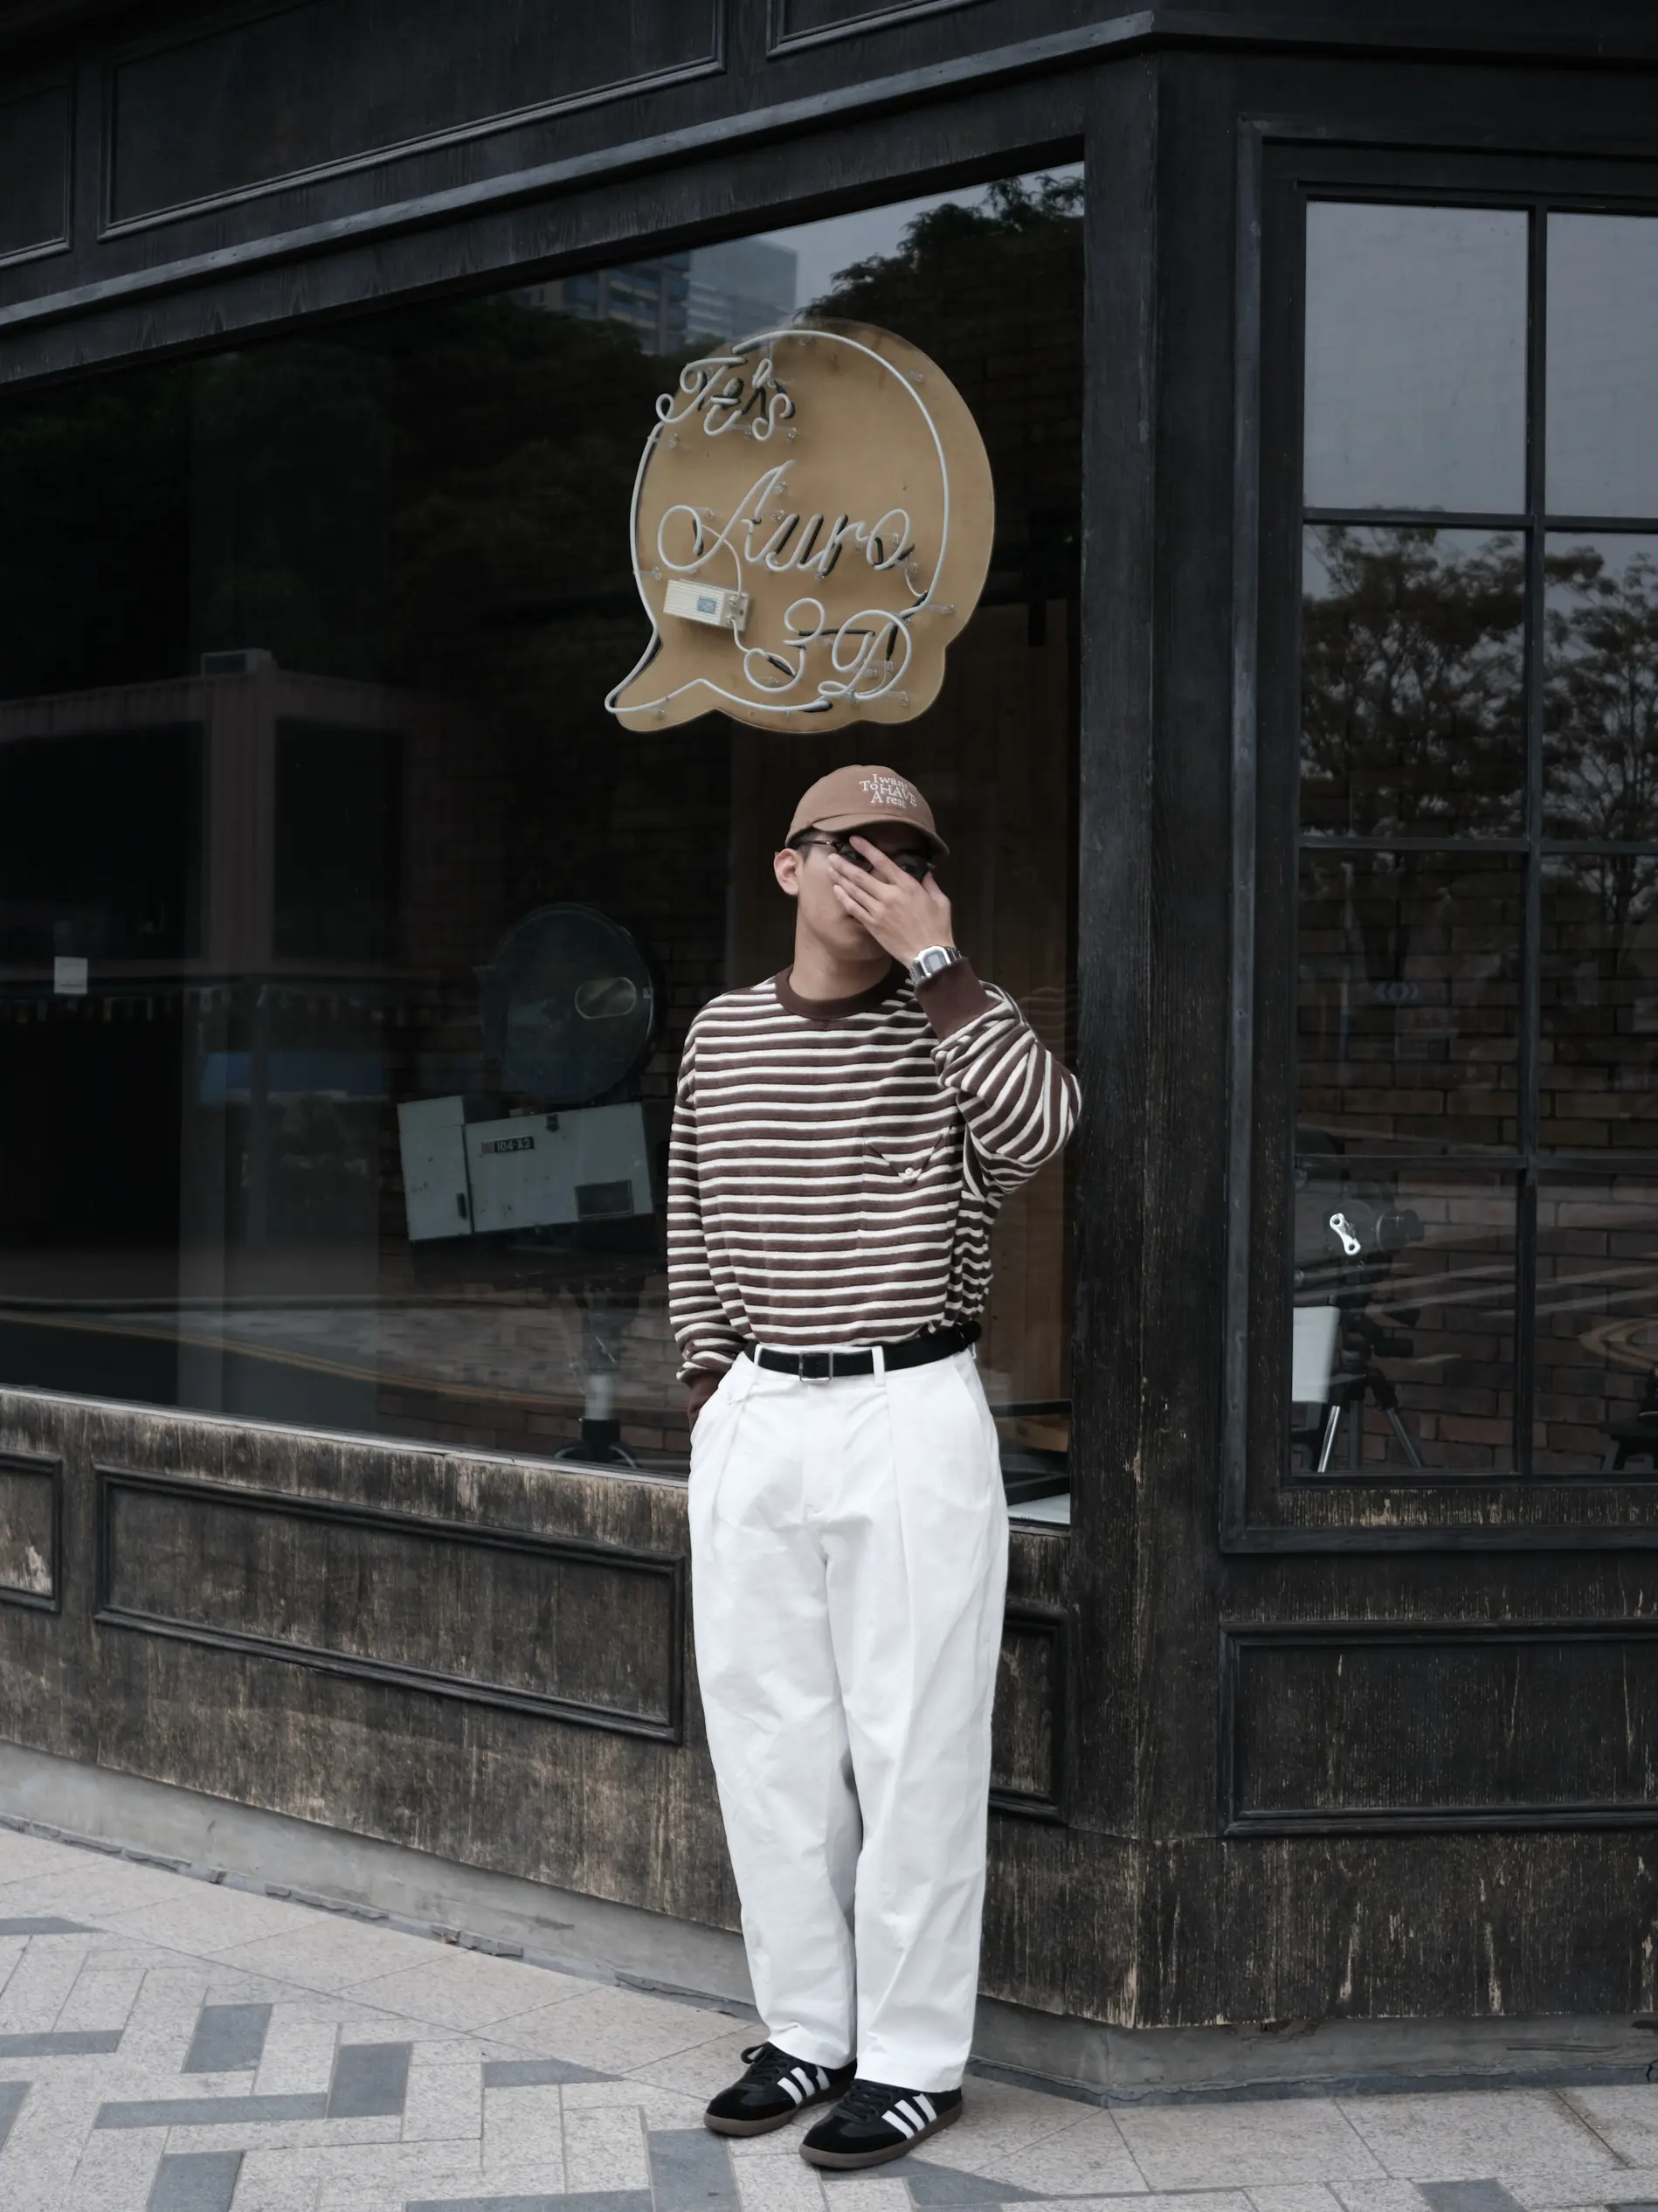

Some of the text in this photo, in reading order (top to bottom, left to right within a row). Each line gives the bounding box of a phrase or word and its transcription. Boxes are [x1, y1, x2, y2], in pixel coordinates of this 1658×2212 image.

[657, 459, 912, 577] Auro
[870, 790, 907, 808] A rest
[879, 783, 917, 807] HAVE
